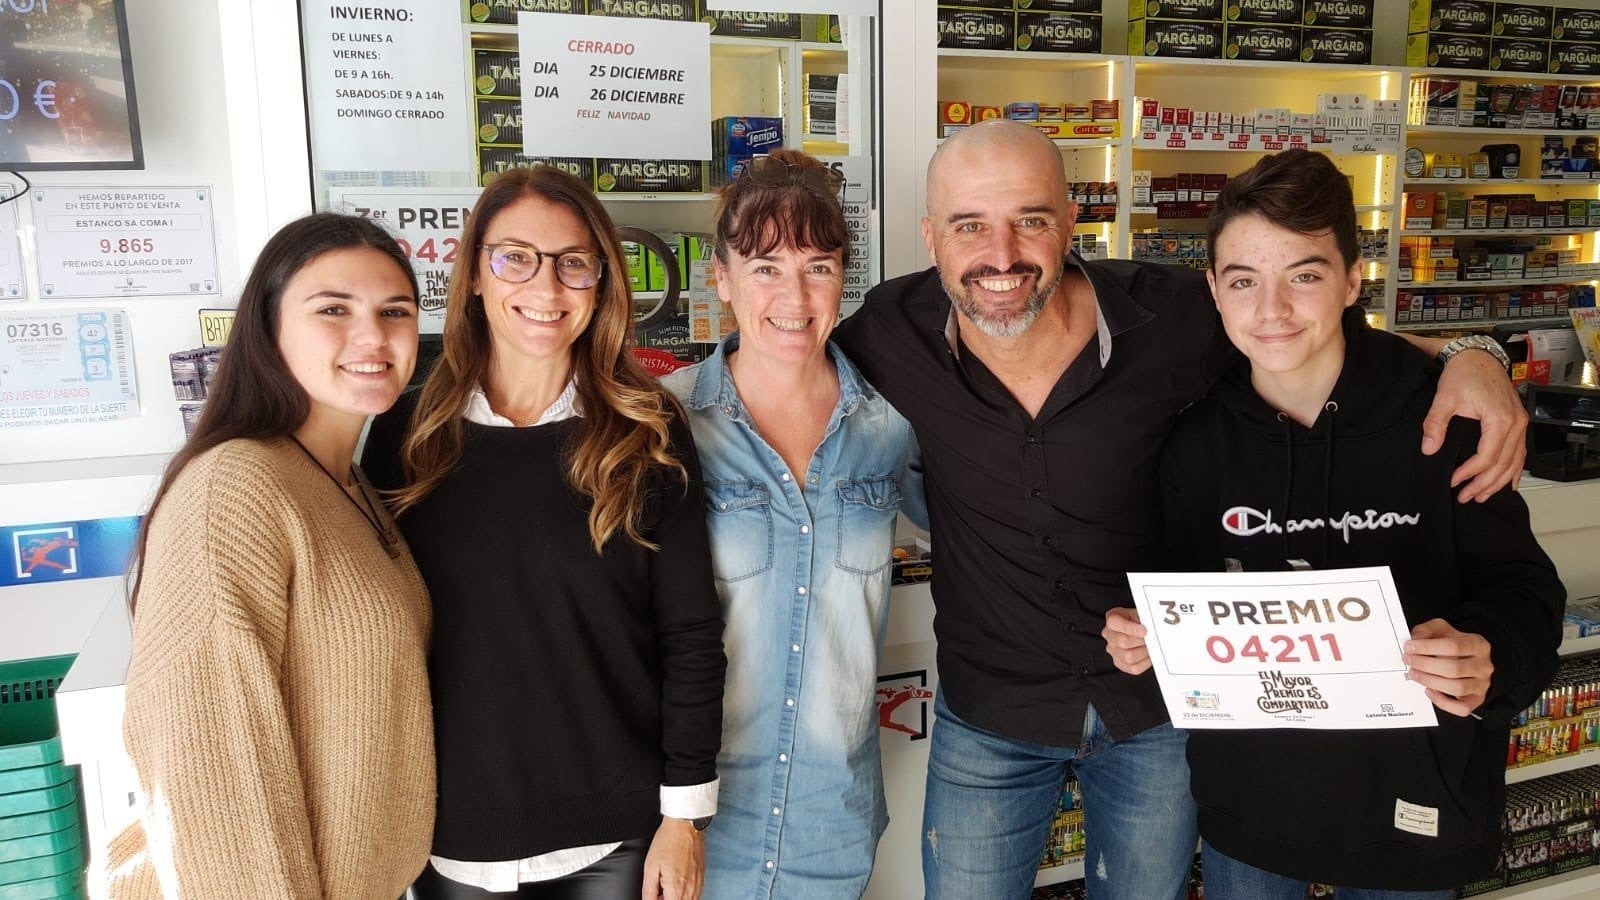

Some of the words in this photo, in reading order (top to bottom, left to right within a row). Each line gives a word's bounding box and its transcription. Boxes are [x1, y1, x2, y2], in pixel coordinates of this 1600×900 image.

[330, 6, 414, 22] INVIERNO:
[602, 1, 683, 17] TARGARD
[1314, 2, 1366, 16] TARGARD
[1438, 9, 1486, 22] TARGARD
[1502, 13, 1546, 27] TARGARD
[938, 21, 1005, 35] TARGARD
[1028, 25, 1093, 39] TARGARD
[332, 32, 345, 42] DE
[349, 33, 383, 43] LUNES
[386, 34, 393, 43] A
[1155, 31, 1214, 45] TARGARD
[1236, 34, 1293, 49] TARGARD
[567, 39, 635, 56] CERRADO
[1311, 38, 1365, 52] TARGARD
[1436, 44, 1484, 57] TARGARD
[332, 50, 381, 60] VIERNES:
[1499, 48, 1543, 61] TARGARD
[334, 69, 348, 78] DE
[351, 70, 358, 79] 9
[360, 70, 369, 79] A
[372, 70, 394, 80] 16h.
[533, 61, 559, 75] DIA
[589, 64, 606, 78] 25
[610, 66, 685, 82] DICIEMBRE
[33, 80, 60, 119] €
[405, 90, 412, 99] 9
[415, 91, 423, 100] A
[426, 90, 444, 101] 14h
[534, 85, 560, 99] DIA
[590, 88, 607, 101] 26
[610, 89, 685, 105] DICIEMBRE
[337, 108, 392, 119] DOMINGO
[395, 109, 445, 119] CERRADO
[576, 109, 601, 119] FELIZ
[607, 110, 651, 121] NAVIDAD
[748, 130, 778, 145] Tempo
[610, 162, 691, 178] TARGARD
[79, 193, 113, 201] HEMOS
[114, 193, 166, 201] REPARTIDO
[65, 202, 78, 210] EN
[80, 202, 102, 210] ESTE
[103, 202, 135, 210] PUNTO
[151, 201, 181, 209] VENTA
[76, 219, 122, 228] ESTANCO
[124, 219, 138, 227] SA
[139, 219, 168, 227] COMA
[100, 238, 154, 254] 9.865
[63, 260, 104, 268] PREMIOS
[426, 271, 435, 279] EL
[7, 322, 63, 338] 07316
[1222, 505, 1421, 544] Champion
[1158, 600, 1198, 625] 3er
[1207, 597, 1371, 625] PREMIO
[1206, 633, 1343, 664] 04211
[1258, 671, 1271, 680] EL
[1269, 670, 1313, 690] MAYOR
[1261, 681, 1305, 700] PREMIO
[1306, 686, 1322, 700] ES
[1256, 696, 1329, 714] COMPARTIRLO
[1514, 829, 1551, 843] TARGARD
[1556, 855, 1590, 869] TARGARD
[1512, 866, 1546, 880] TARGARD
[1464, 878, 1500, 893] TARGARD
